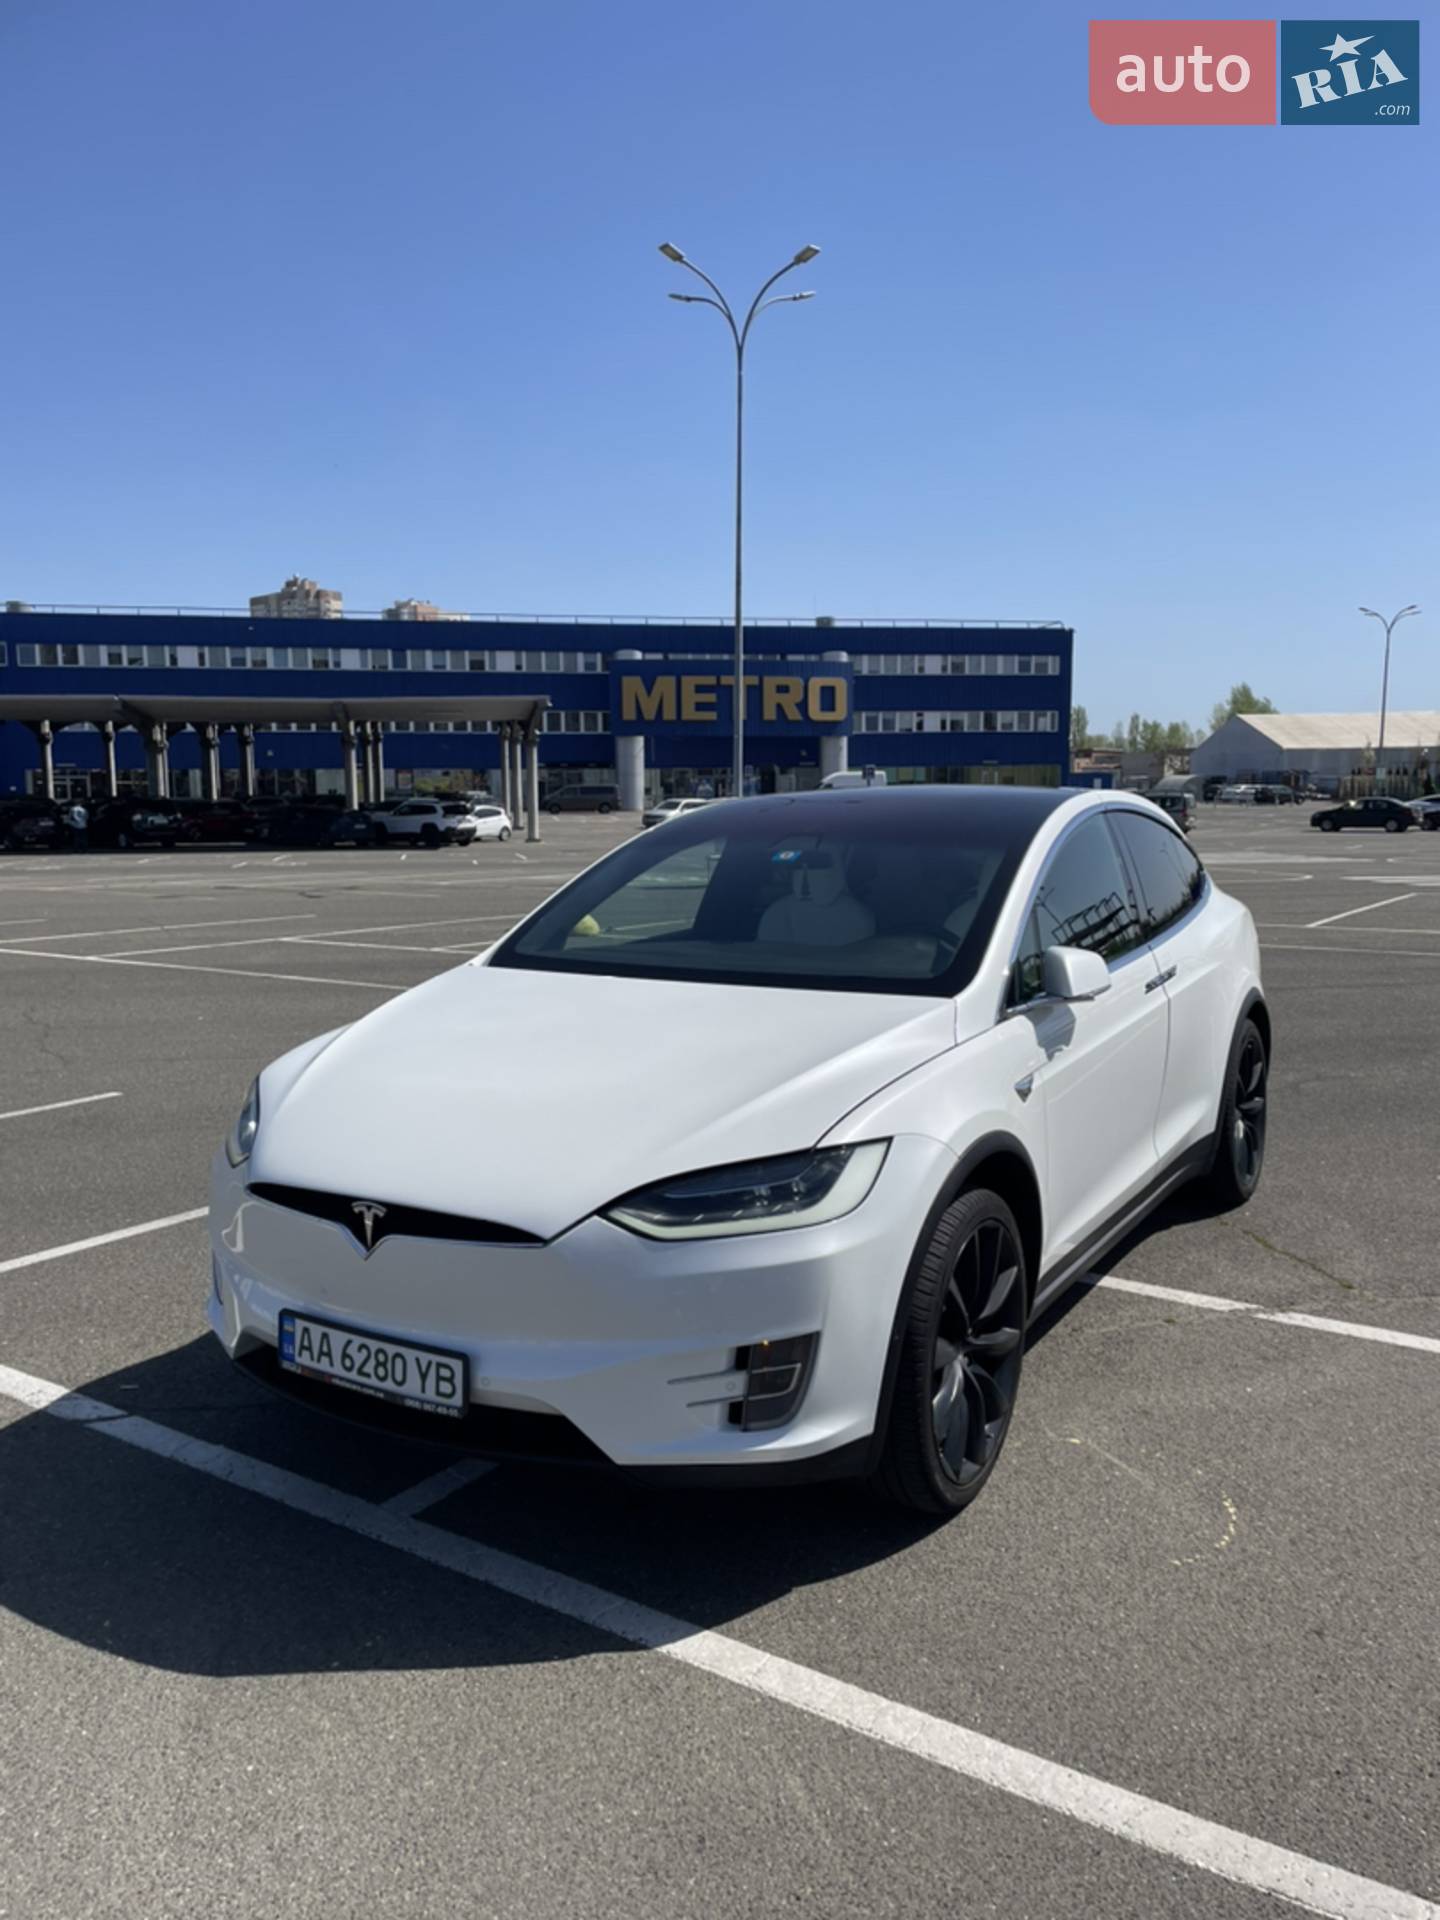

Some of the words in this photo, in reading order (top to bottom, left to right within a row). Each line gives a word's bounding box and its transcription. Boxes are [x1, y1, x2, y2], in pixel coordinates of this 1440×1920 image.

[621, 675, 848, 722] METRO
[298, 1326, 334, 1368] AA
[340, 1339, 407, 1388] 6280
[415, 1356, 457, 1400] YB
